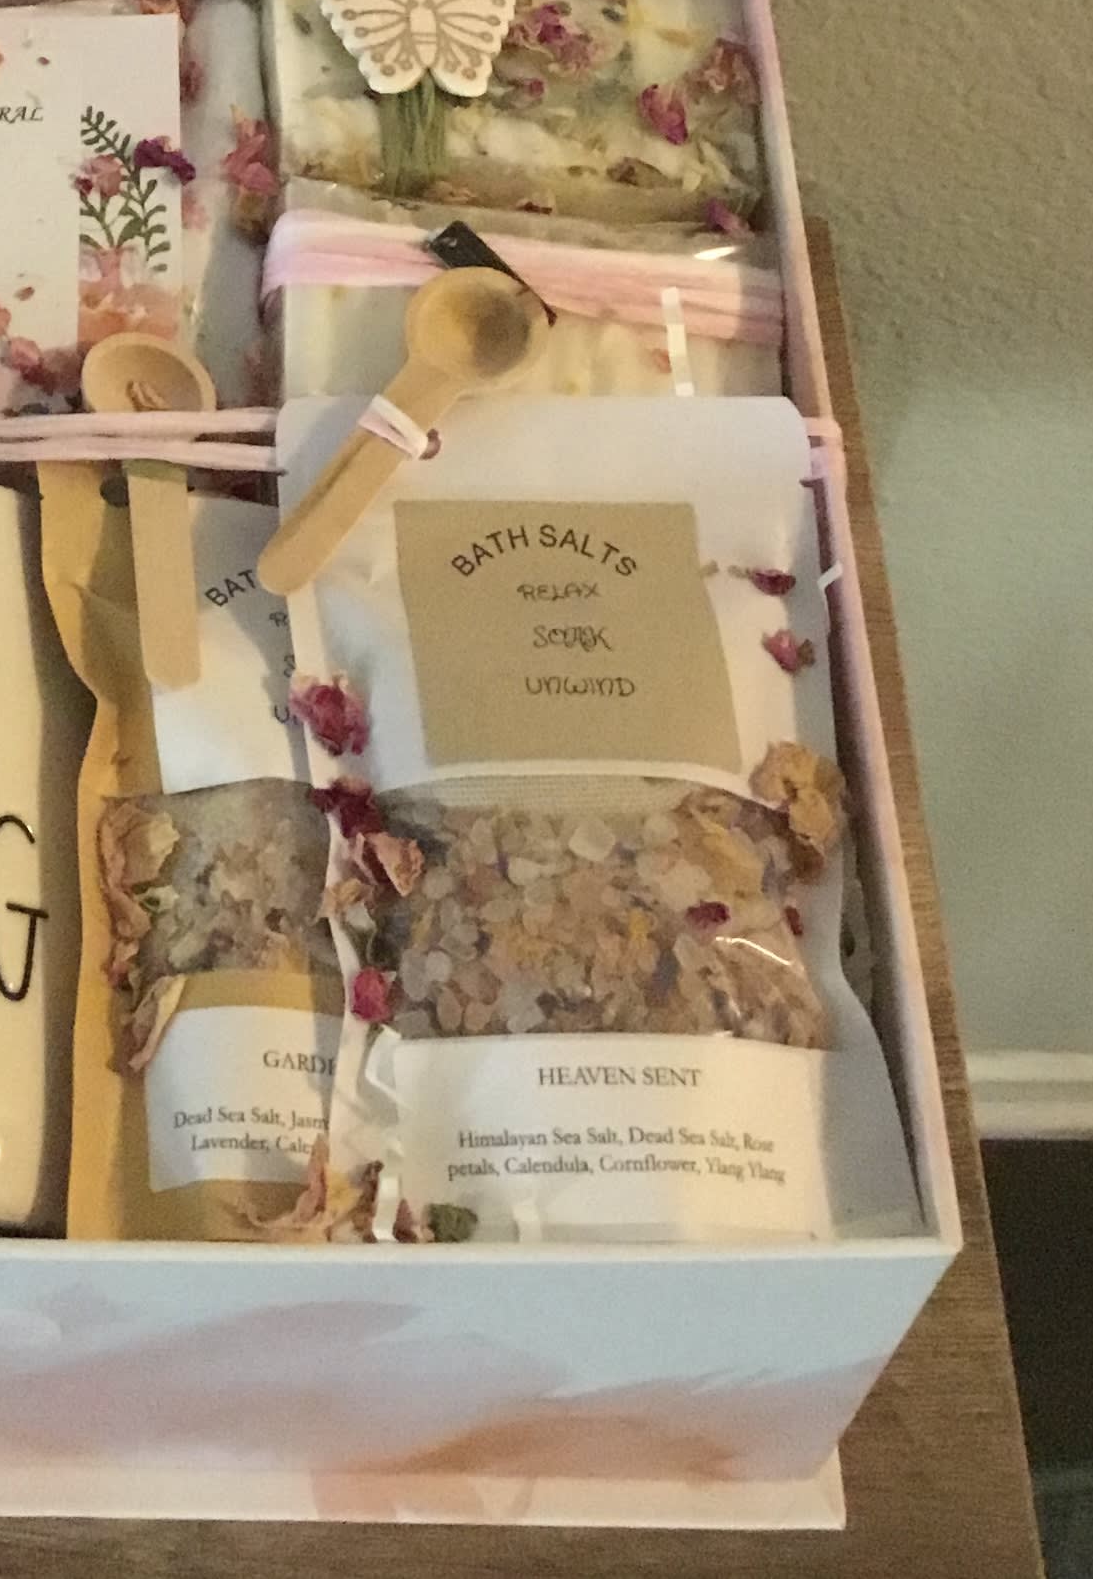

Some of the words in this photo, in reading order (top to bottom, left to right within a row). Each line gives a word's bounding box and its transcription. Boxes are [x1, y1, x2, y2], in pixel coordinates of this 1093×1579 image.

[451, 524, 530, 577] BATH
[538, 523, 638, 577] SALTS
[204, 569, 257, 607] BAT
[516, 581, 601, 602] RELAX
[537, 1067, 637, 1087] HEAVEN
[641, 1067, 702, 1088] SENT
[173, 1107, 213, 1129] Dead
[217, 1105, 245, 1123] Sea
[250, 1106, 286, 1128] Salt,
[191, 1132, 270, 1154] Lavender,
[459, 1128, 548, 1152] Himalayan
[552, 1126, 582, 1146] Sea
[586, 1126, 623, 1148] Salt,
[629, 1125, 674, 1146] Dead
[678, 1126, 706, 1147] Sea
[709, 1128, 740, 1152] Salt,
[742, 1133, 775, 1153] Rose
[447, 1159, 500, 1182] petals,
[503, 1156, 594, 1177] Calendula,
[599, 1153, 702, 1176] Cornflower,
[704, 1155, 746, 1183] Ylang
[749, 1160, 786, 1184] Ylang
